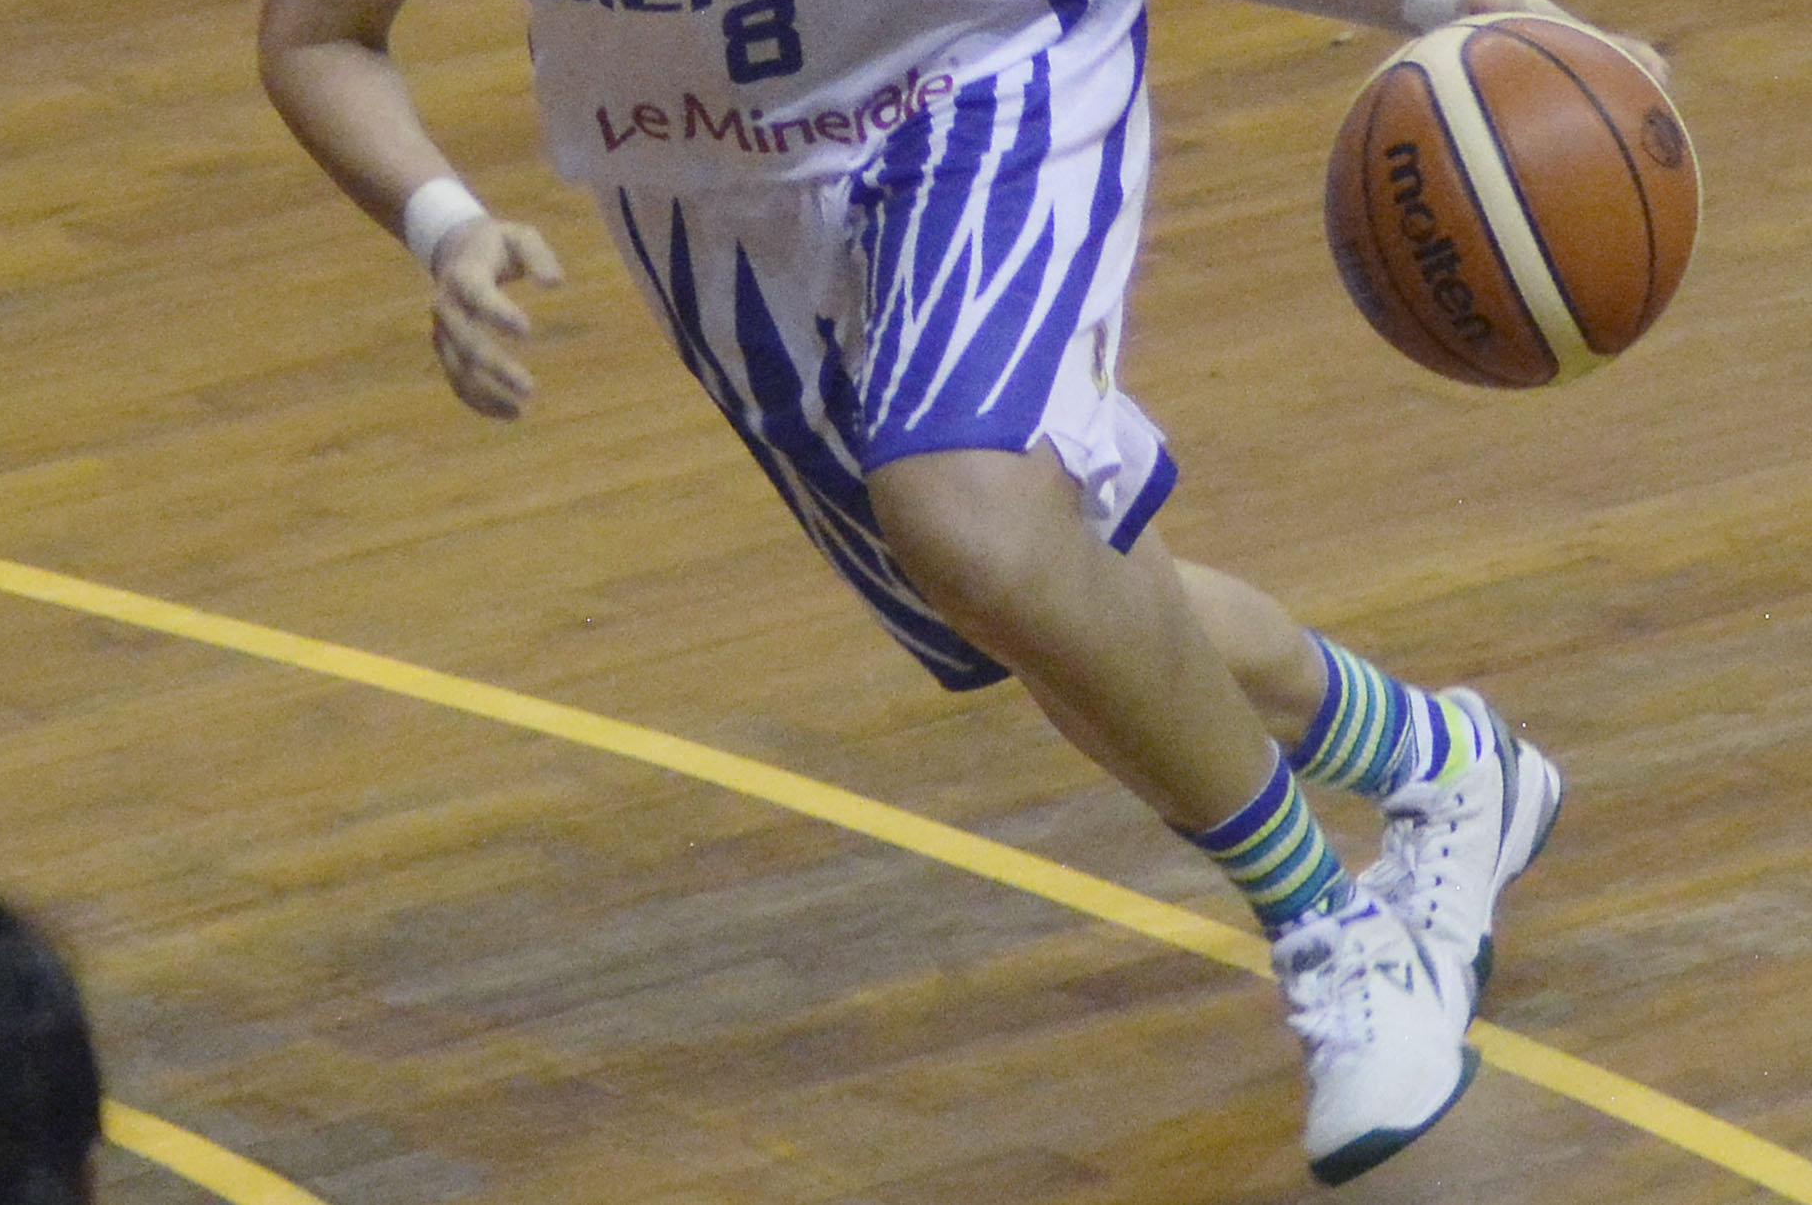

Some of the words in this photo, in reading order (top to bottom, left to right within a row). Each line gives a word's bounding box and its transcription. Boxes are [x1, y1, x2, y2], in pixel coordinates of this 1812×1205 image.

[596, 103, 670, 152] Le
[683, 66, 954, 153] Minerale
[1386, 143, 1494, 343] molten
